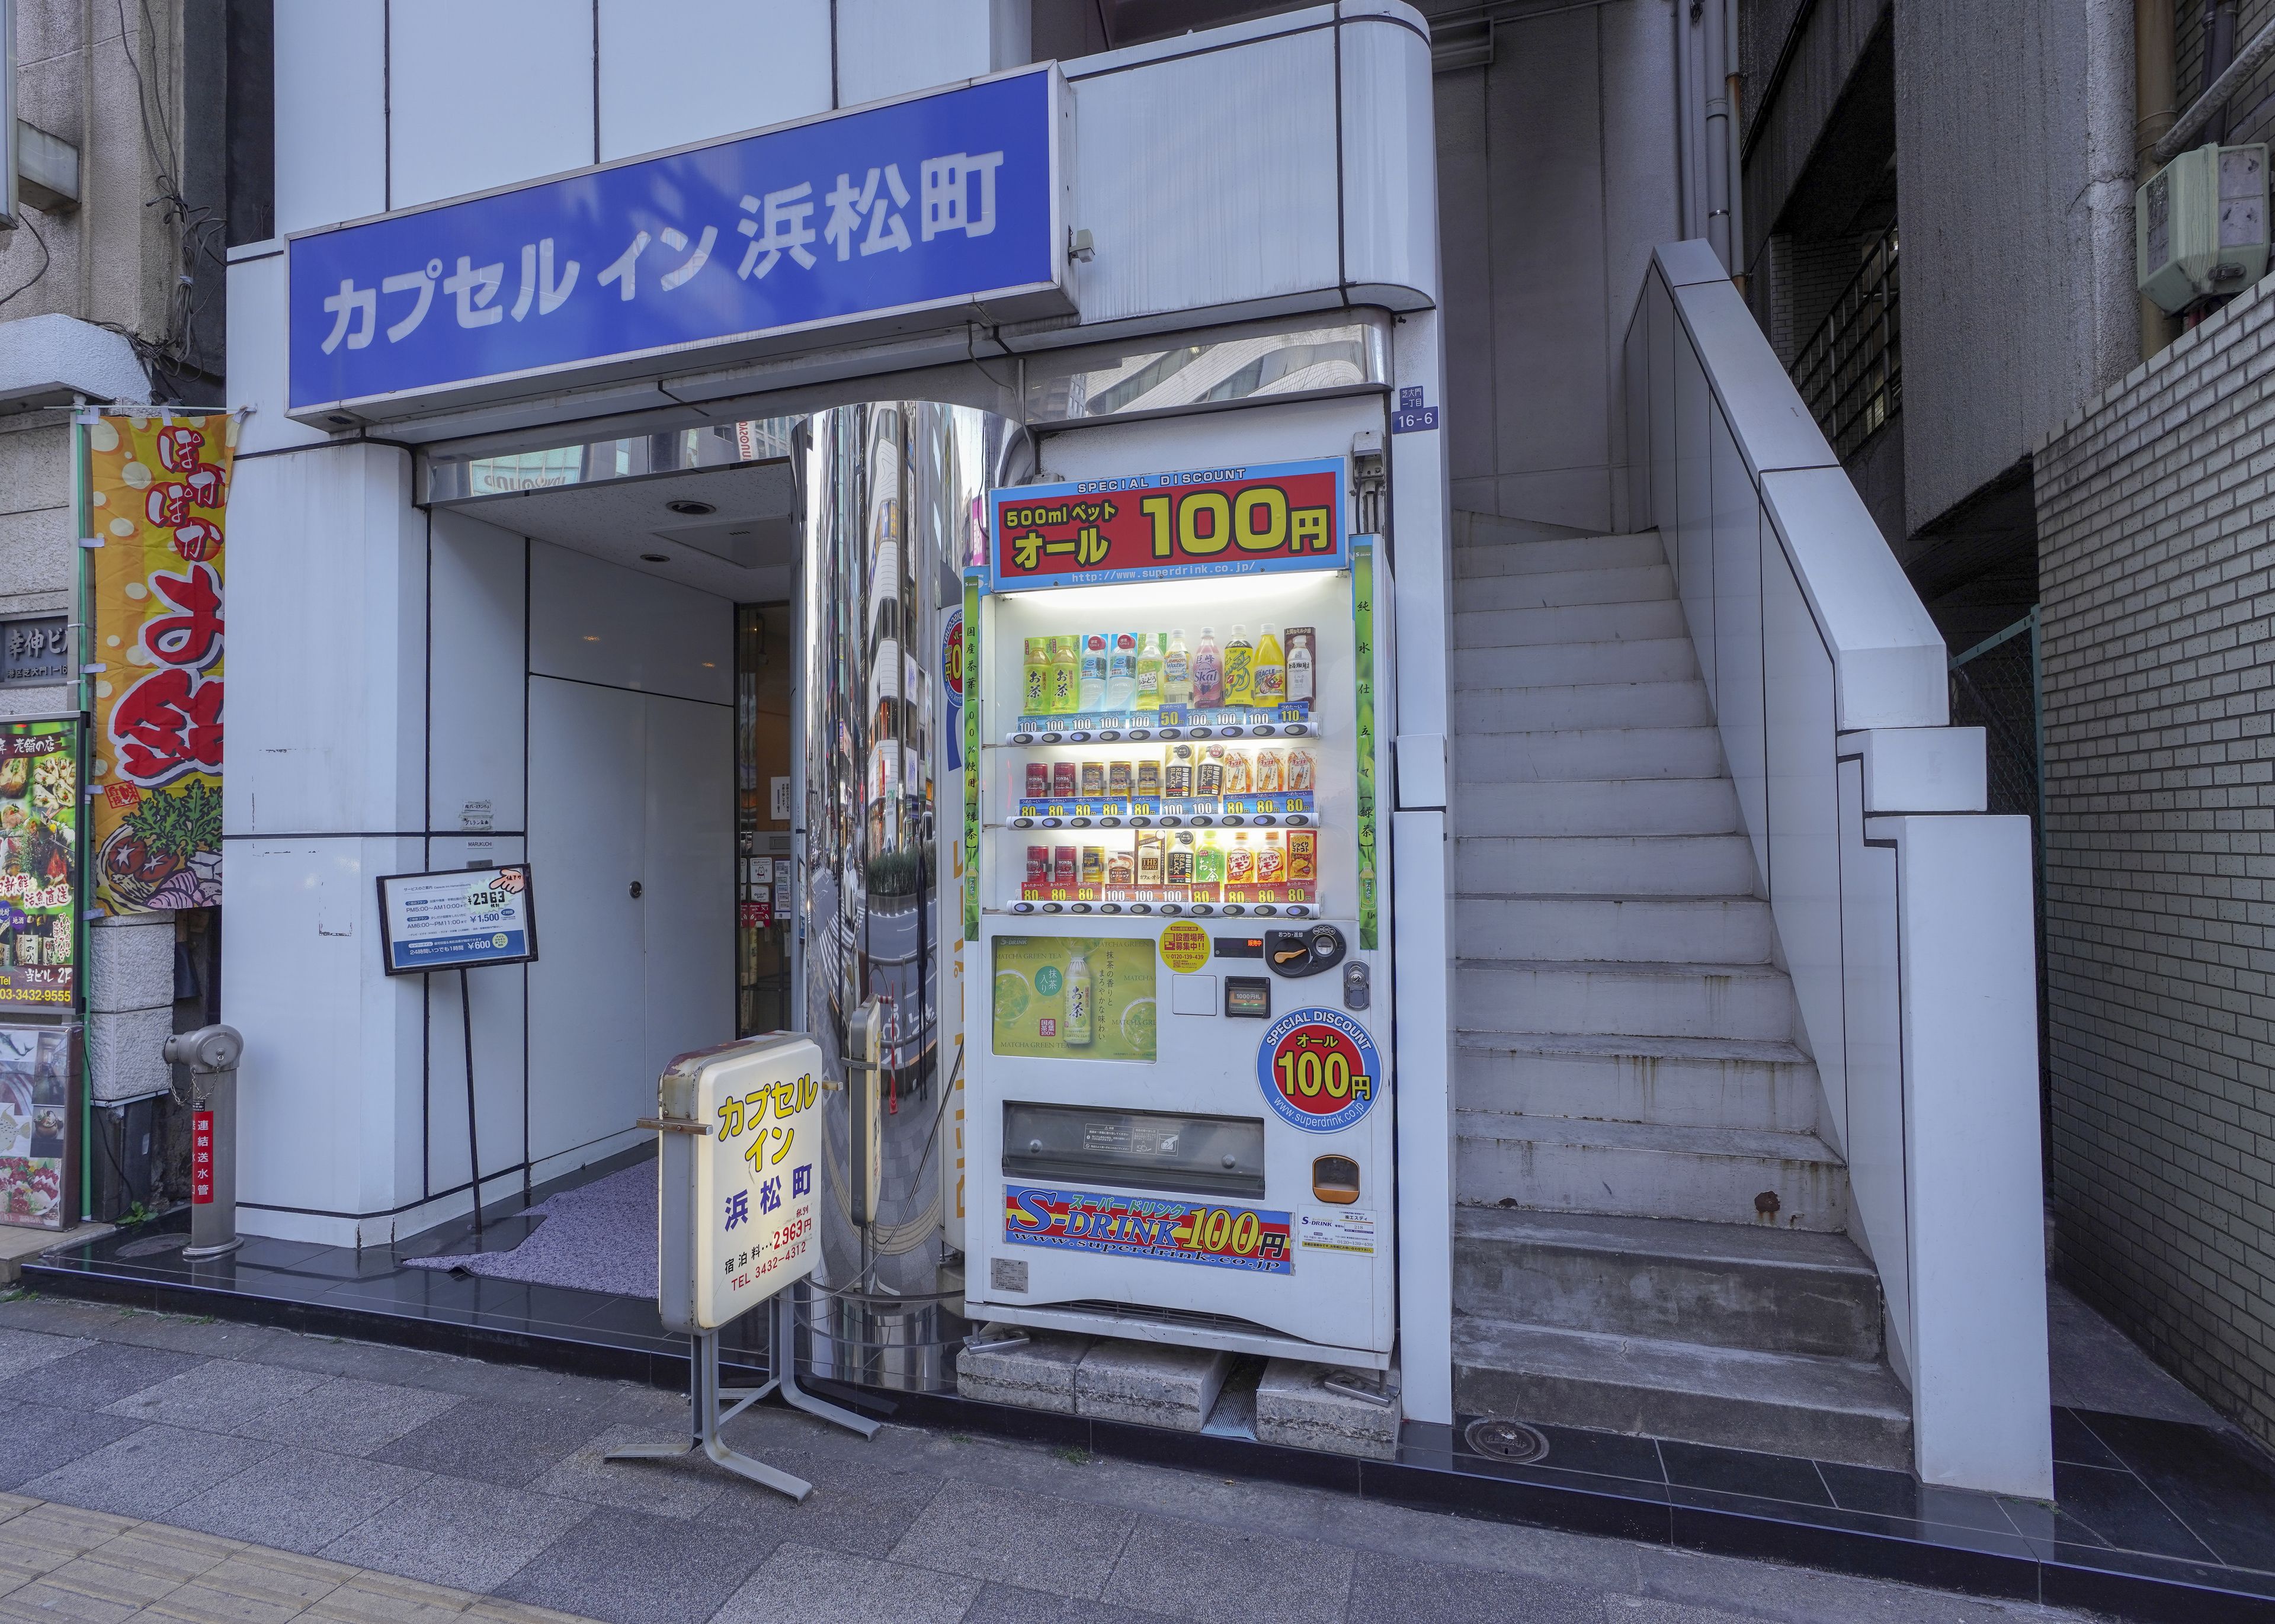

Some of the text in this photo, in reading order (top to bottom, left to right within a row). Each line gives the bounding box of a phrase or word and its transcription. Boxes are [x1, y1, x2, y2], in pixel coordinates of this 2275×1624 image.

[321, 150, 1004, 356] カプセル イン 浜松町
[1402, 388, 1421, 397] 芝大門
[1403, 399, 1421, 407] 一丁目
[1399, 412, 1433, 427] 16-6
[1078, 468, 1246, 493] SPECIAL DISCOUNT
[1005, 499, 1117, 528] 500mlペット
[1140, 484, 1331, 558] 100円
[1014, 528, 1110, 570] オール
[1072, 561, 1255, 582] http://www.superdrink.co.jp/
[1196, 654, 1215, 664] 巨峰
[1027, 671, 1041, 698] お茶
[1055, 670, 1068, 697] お茶
[14, 736, 55, 753] 老舗の店
[1229, 861, 1251, 871] レモン
[1258, 861, 1280, 871] レモン
[25, 886, 69, 907] 活魚直送
[470, 913, 499, 923] ¥1,500
[467, 941, 491, 949] ¥600
[1176, 933, 1204, 942] 設置場所
[1176, 942, 1204, 951] 募集中!!
[0, 976, 10, 985] Tel
[25, 968, 72, 983] 当ビル 2F
[1040, 975, 1048, 993] 入り
[1049, 969, 1057, 990] 抹茶
[0, 988, 71, 1002] 03-3432-9555
[1069, 986, 1083, 1018] お茶
[1266, 1010, 1372, 1050] SPECIAL DISCOUNT
[1297, 1033, 1338, 1048] オール
[1277, 1050, 1372, 1101] 100円
[718, 1073, 819, 1142] カプセル
[1274, 1097, 1364, 1126] www.superdrink.co.jp
[197, 1121, 209, 1195] 連結送水管
[745, 1127, 794, 1173] イン
[725, 1163, 813, 1232] 浜松町
[1069, 1195, 1185, 1219] スーパードリンク
[796, 1205, 809, 1218] 税別
[1008, 1190, 1182, 1247] S-DRINK
[1302, 1217, 1332, 1227] S-DRINK
[1182, 1207, 1286, 1258] 100円
[1014, 1233, 1280, 1271] www.superdrink.co.jp
[731, 1241, 806, 1291] TEL 3432-4312
